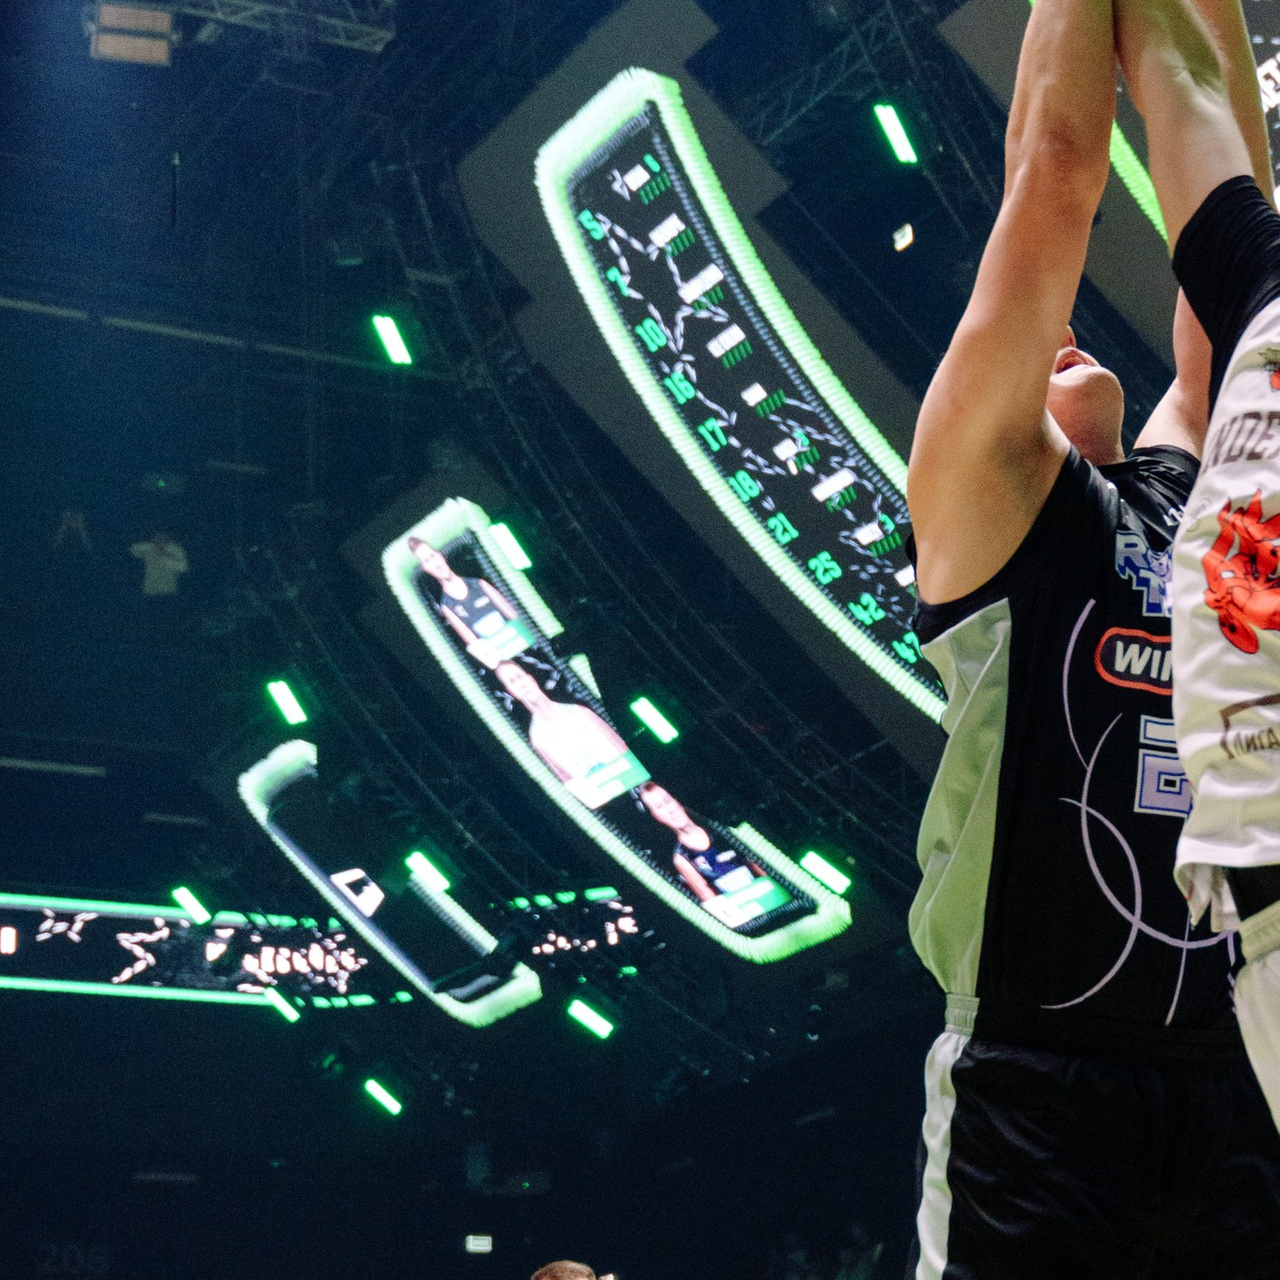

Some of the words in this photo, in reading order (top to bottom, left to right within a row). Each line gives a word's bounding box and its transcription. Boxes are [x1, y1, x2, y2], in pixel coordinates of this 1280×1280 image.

[579, 209, 604, 240] 5
[635, 318, 667, 352] 10
[663, 371, 696, 405] 16
[697, 416, 728, 452] 17
[727, 470, 760, 503] 18
[767, 512, 799, 545] 21
[808, 550, 842, 585] 25
[848, 592, 886, 626] 42
